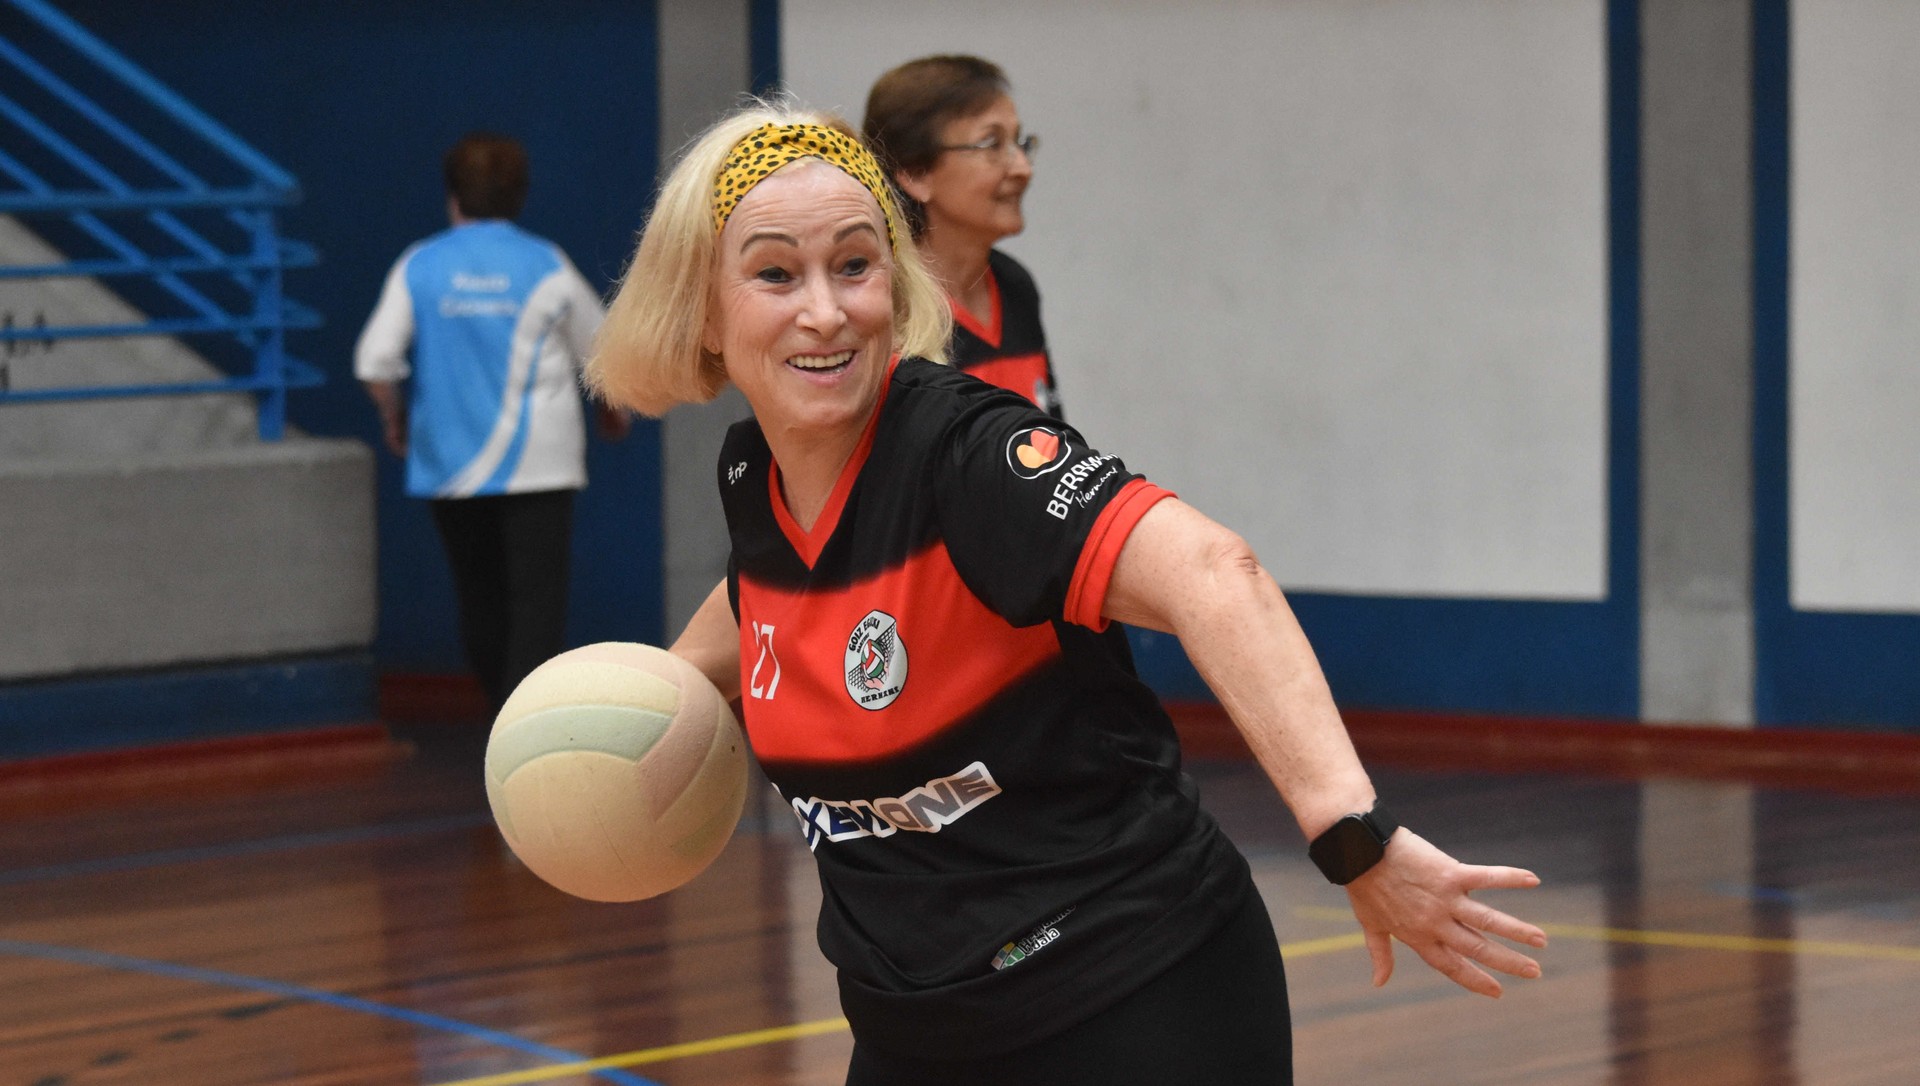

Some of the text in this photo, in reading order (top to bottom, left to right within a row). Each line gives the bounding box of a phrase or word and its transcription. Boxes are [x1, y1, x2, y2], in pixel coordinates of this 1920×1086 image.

[750, 620, 781, 700] 27
[848, 626, 864, 652] GOIZ
[794, 768, 996, 847] XEMONE
